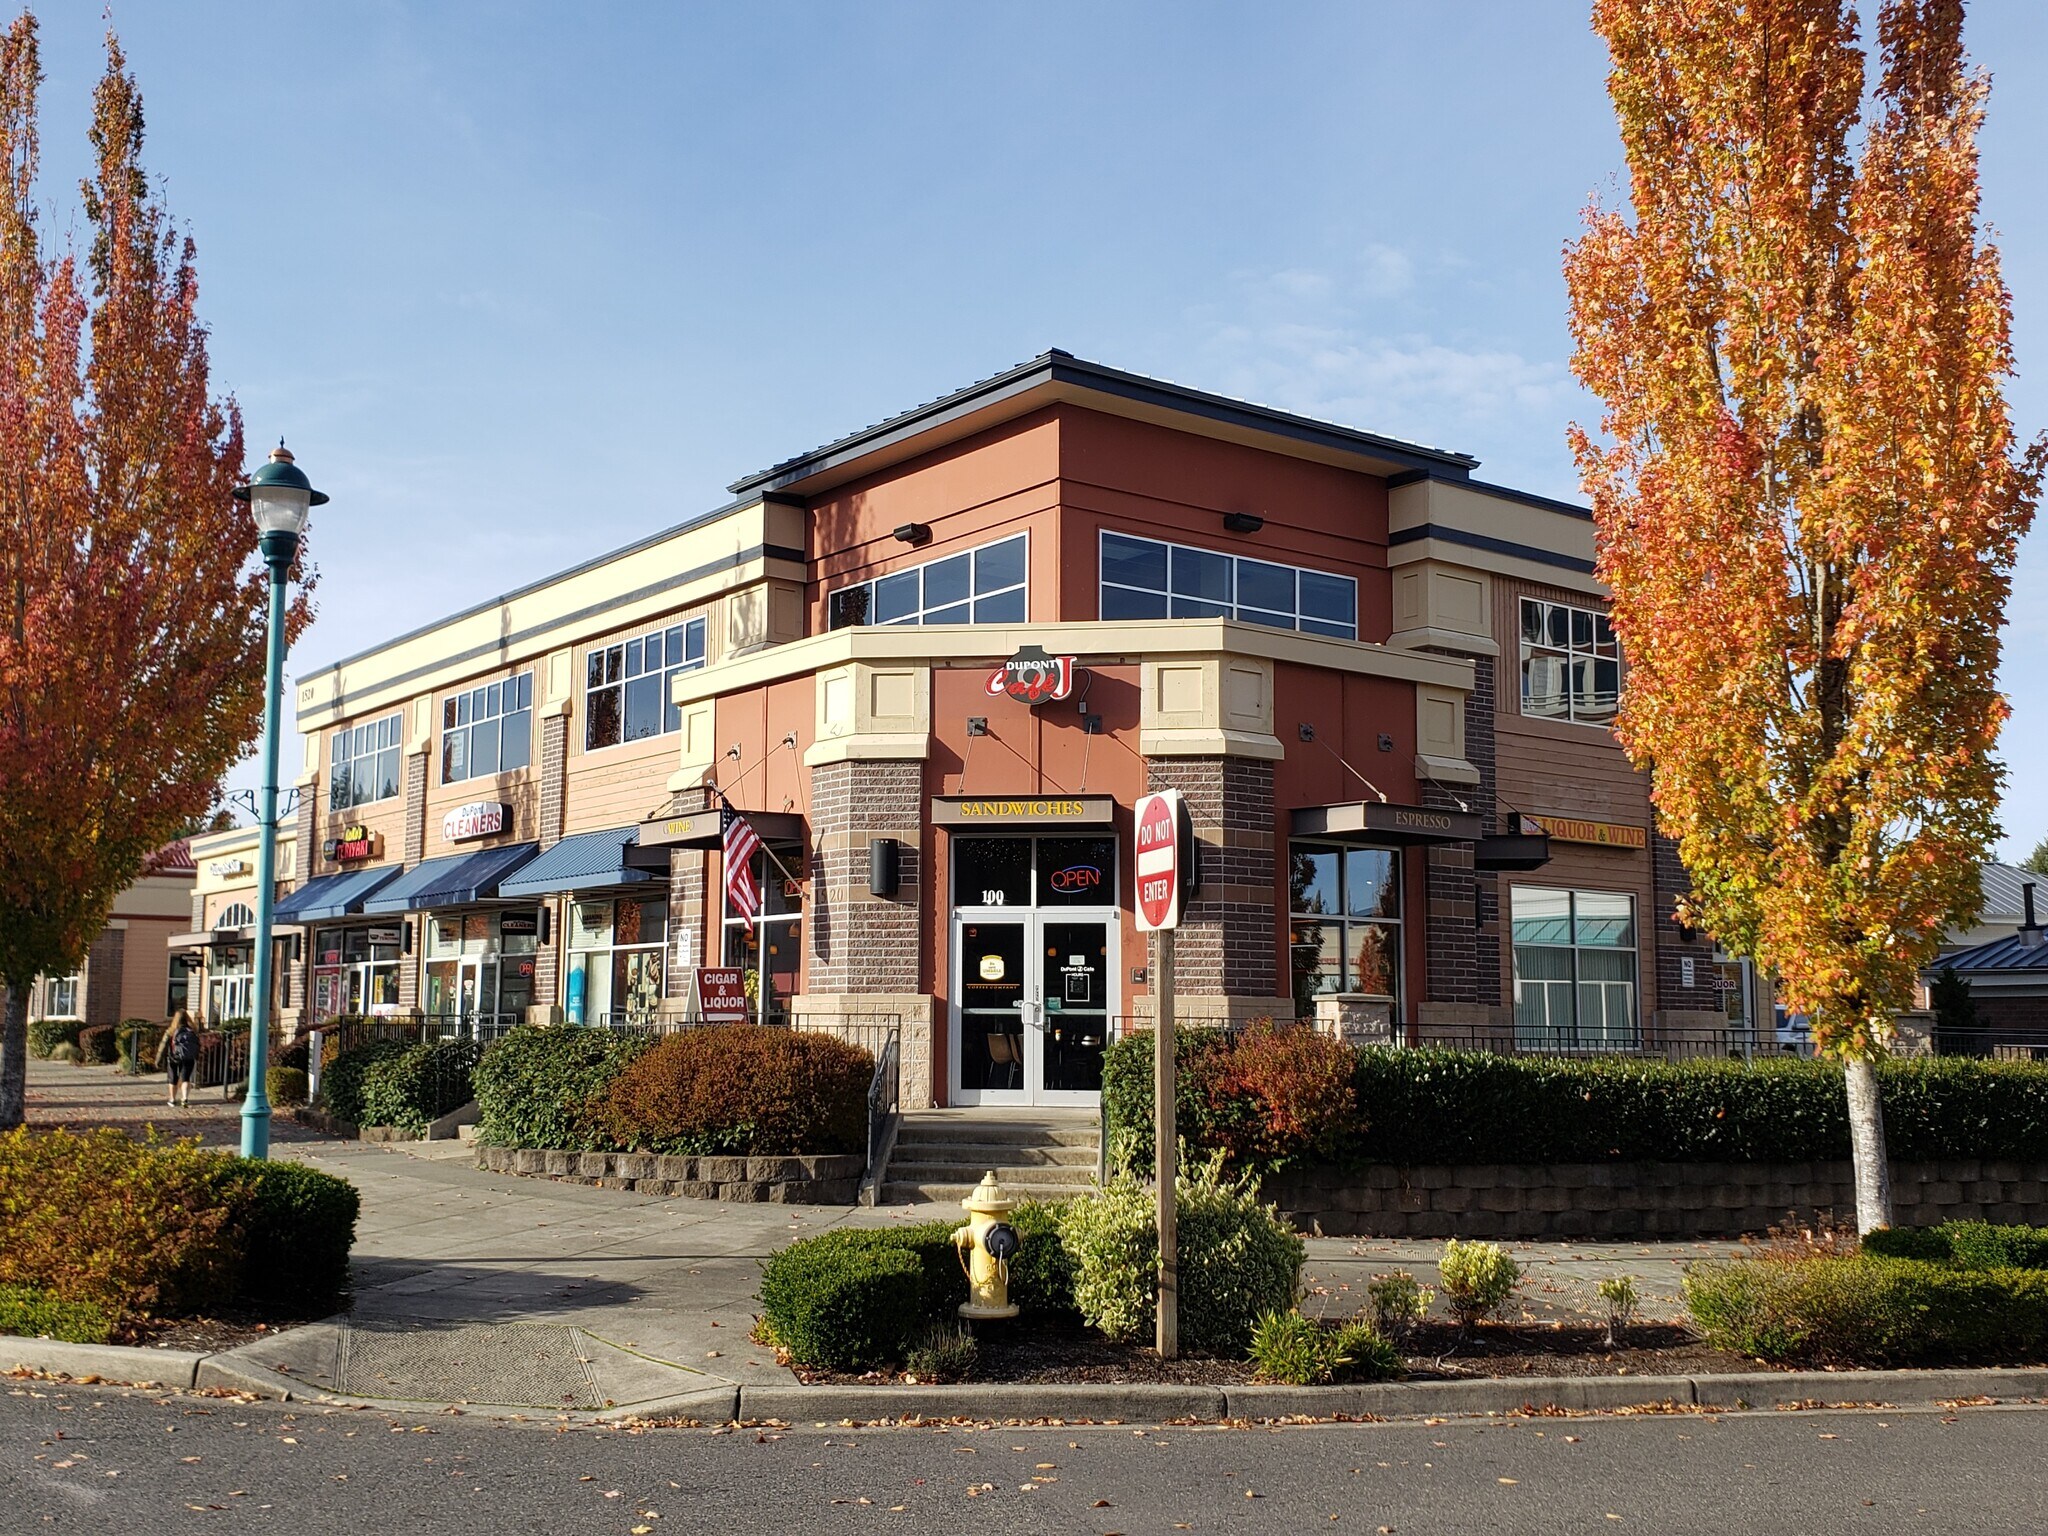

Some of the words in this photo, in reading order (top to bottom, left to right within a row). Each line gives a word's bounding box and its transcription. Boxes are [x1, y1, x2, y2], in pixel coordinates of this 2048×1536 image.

[1006, 660, 1056, 671] DUPONT
[1050, 656, 1077, 700] J
[961, 801, 1084, 816] SANDWICHES
[444, 812, 501, 839] CLEANERS
[667, 820, 692, 835] WINE
[1395, 811, 1451, 830] ESPRESSO
[1141, 824, 1152, 846] DO
[1155, 818, 1170, 842] NOT
[1541, 817, 1596, 841] LIQUOR
[1598, 829, 1606, 842] &
[1608, 826, 1645, 846] WINE
[337, 839, 368, 860] TERIYAKI
[1051, 870, 1100, 887] OPEN
[981, 890, 1004, 905] 100
[1144, 879, 1168, 902] ENTER
[680, 933, 689, 942] NO
[520, 963, 533, 974] OPEN
[1683, 960, 1692, 969] NO
[704, 973, 738, 985] CIGAR
[1712, 981, 1735, 989] QUOR
[718, 985, 727, 996] &
[704, 996, 744, 1009] LIQUOR
